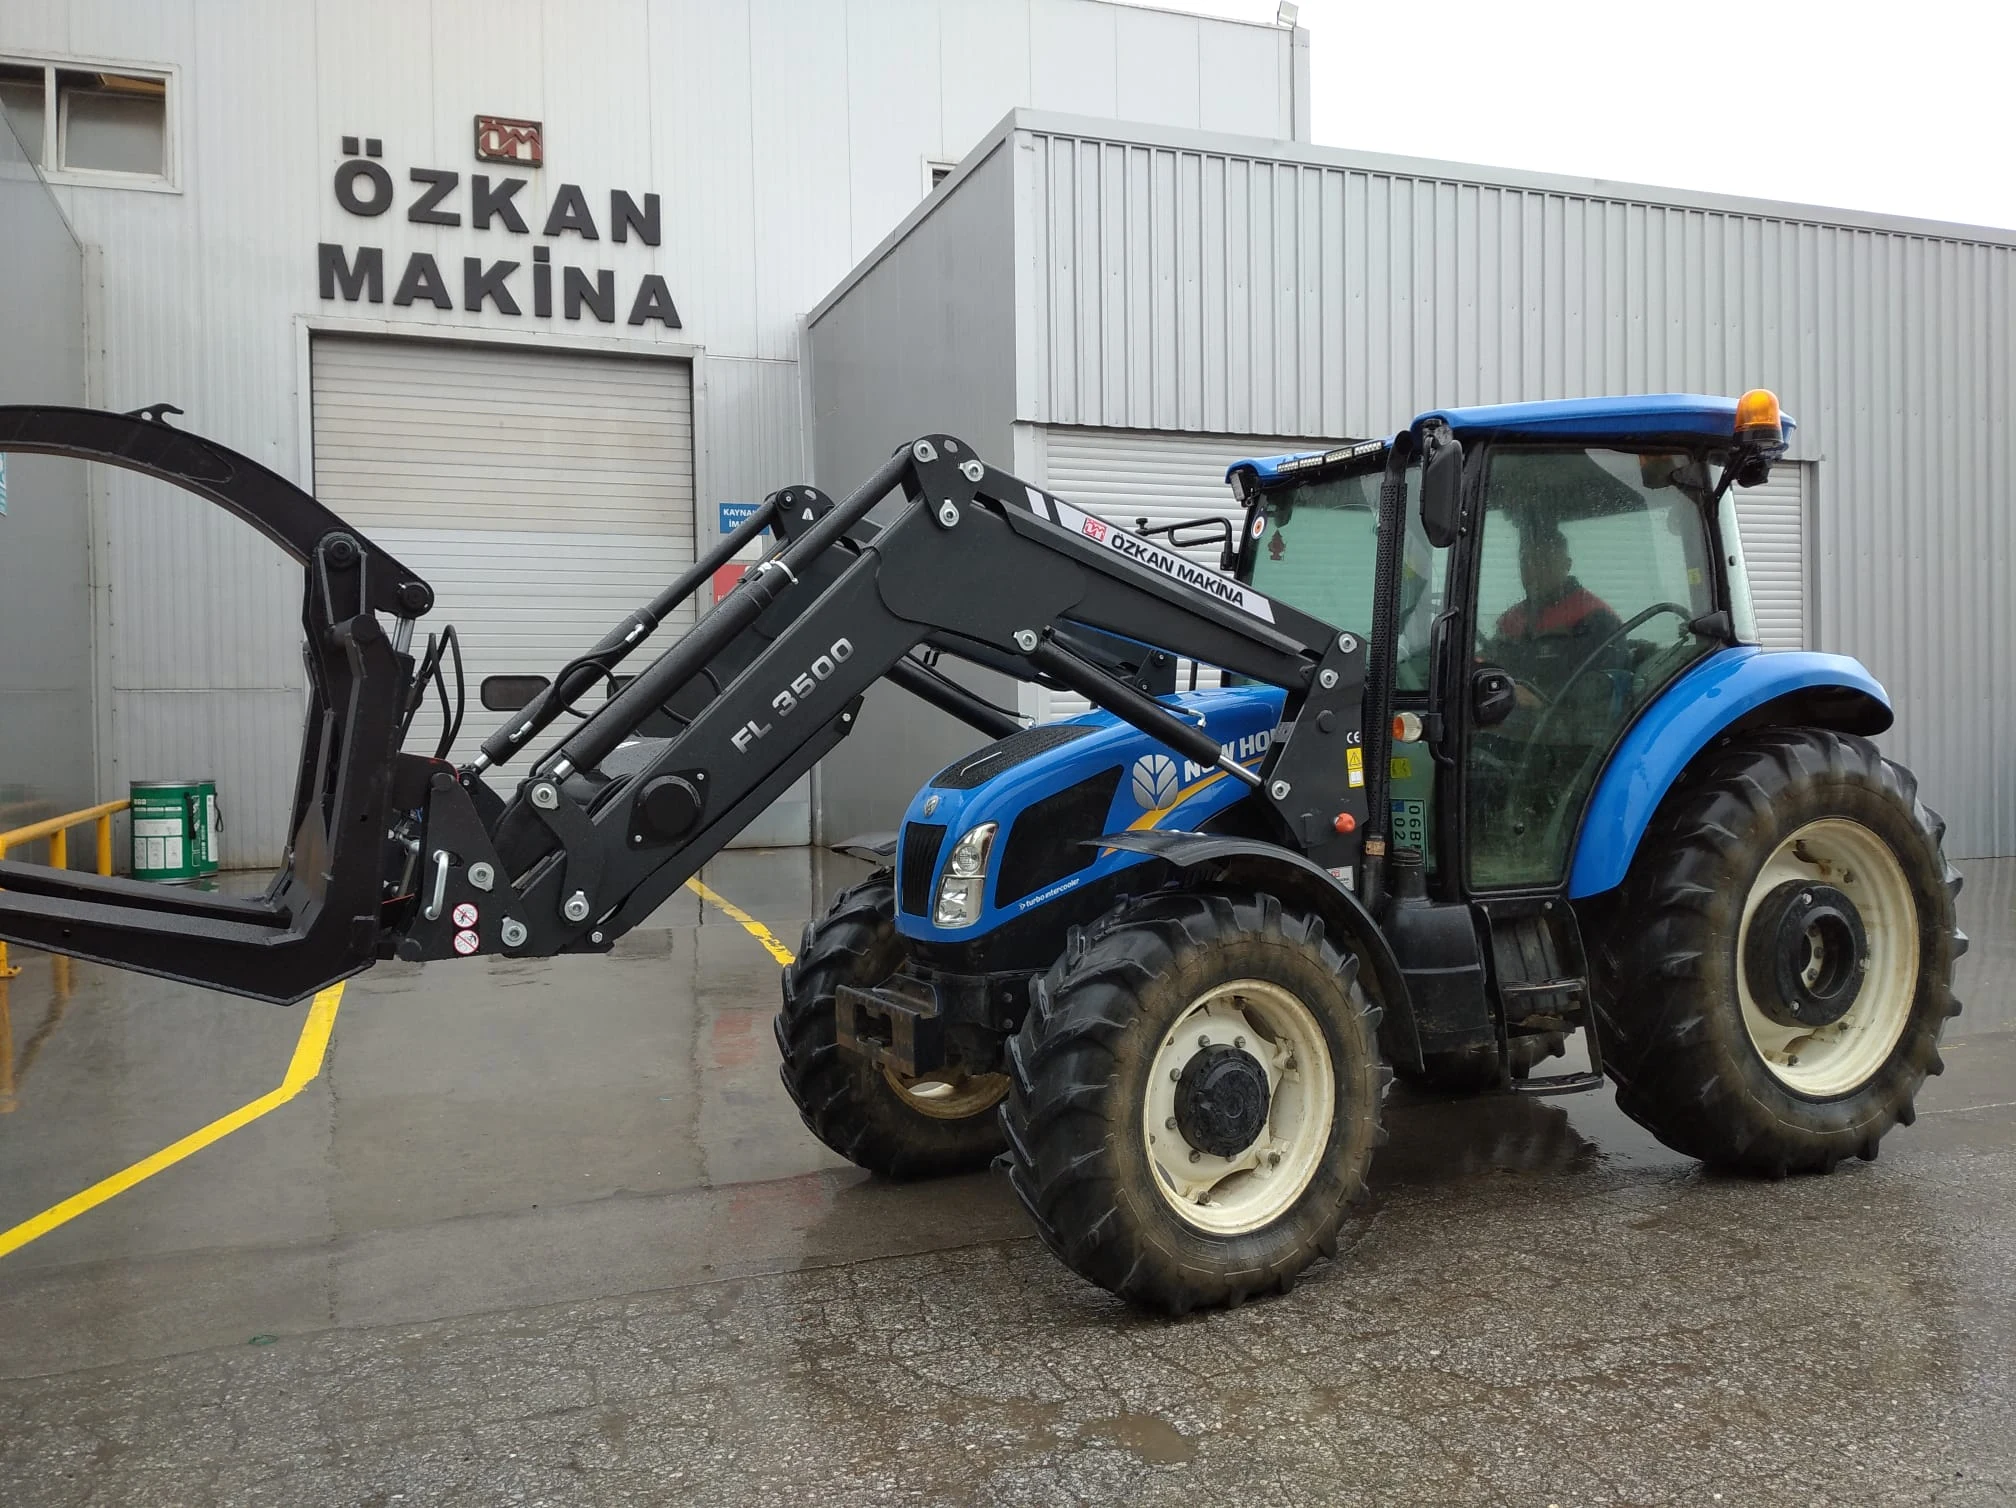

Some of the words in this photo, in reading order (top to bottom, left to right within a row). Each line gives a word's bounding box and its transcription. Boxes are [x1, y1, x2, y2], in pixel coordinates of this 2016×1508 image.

[334, 135, 661, 247] ÖZKAN
[318, 243, 683, 329] MAKİNA
[723, 508, 756, 517] KAYNA
[1111, 531, 1175, 573] ÖZKAN
[1177, 563, 1244, 607] MAKİNA
[730, 720, 773, 755] FL
[771, 637, 854, 717] 3500
[1026, 893, 1045, 908] turbo
[1045, 878, 1080, 899] intercooler
